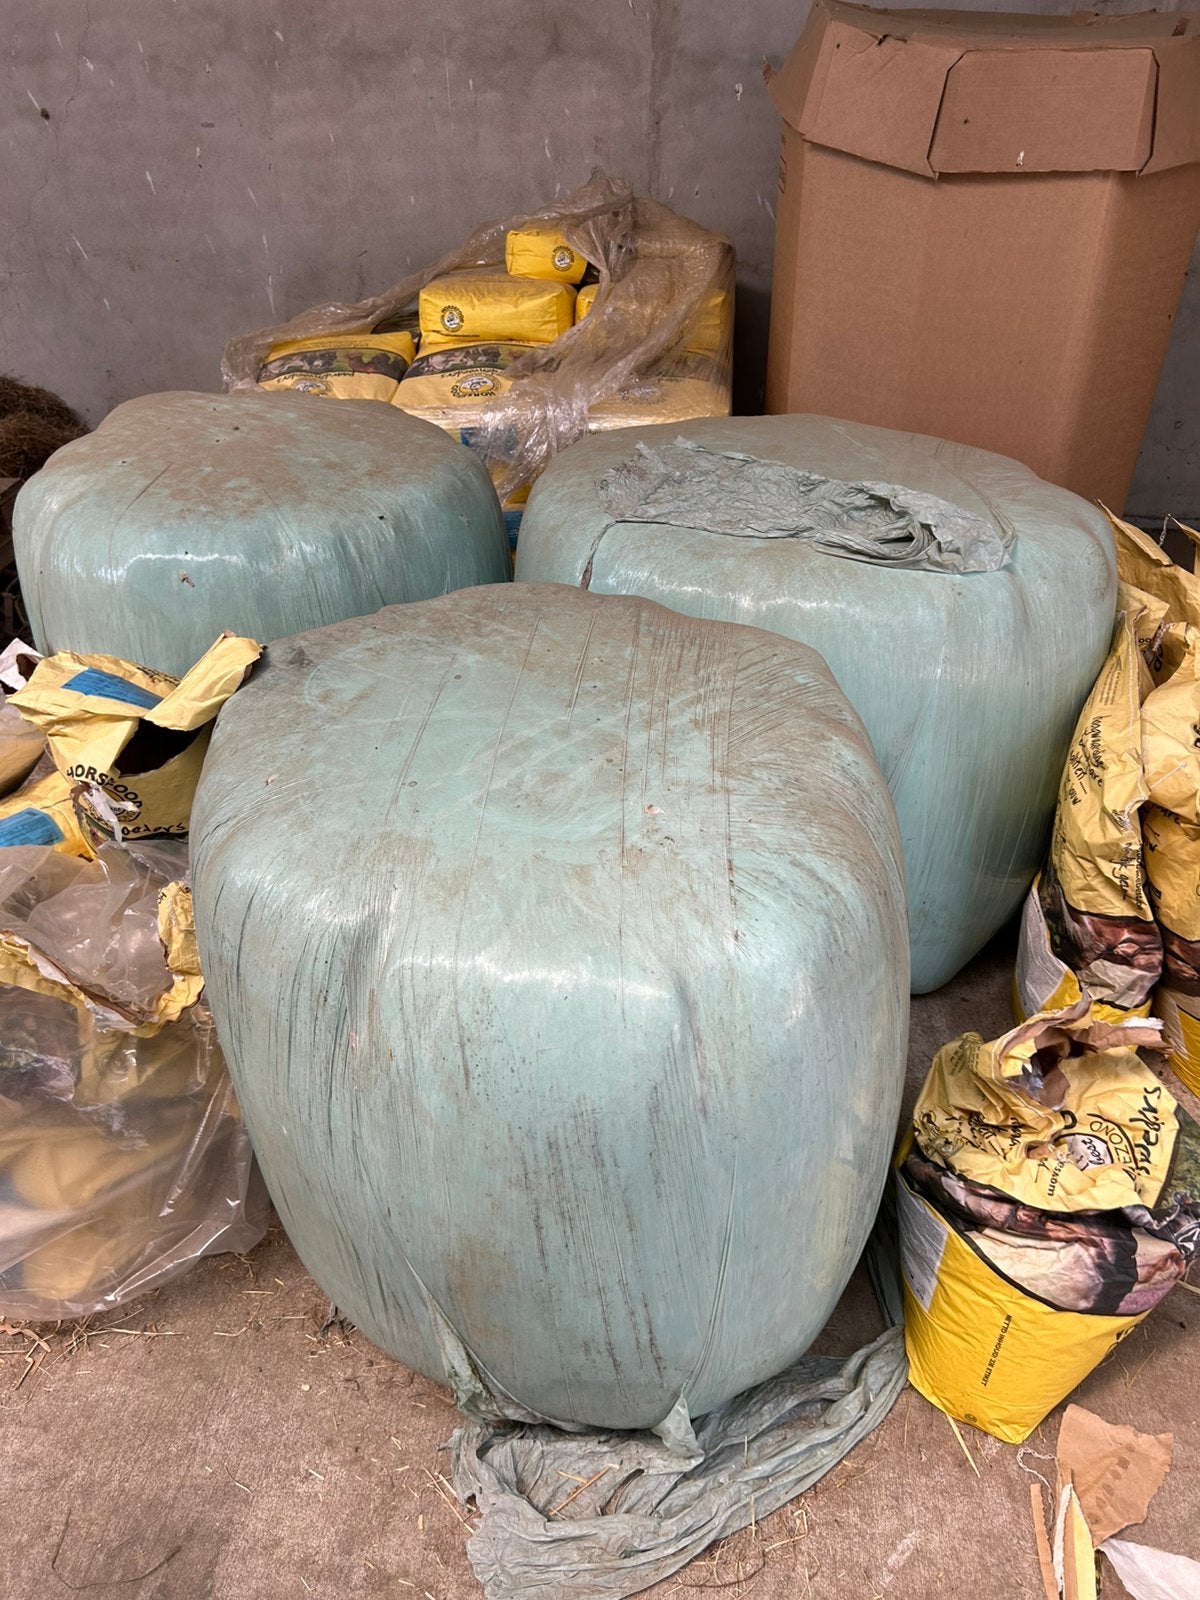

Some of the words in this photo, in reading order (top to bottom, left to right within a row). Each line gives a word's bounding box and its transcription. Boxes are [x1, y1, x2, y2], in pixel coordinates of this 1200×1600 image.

[1089, 1120, 1133, 1164] EZOND
[1000, 1313, 1013, 1334] NETTO
[988, 1358, 997, 1368] ZIE
